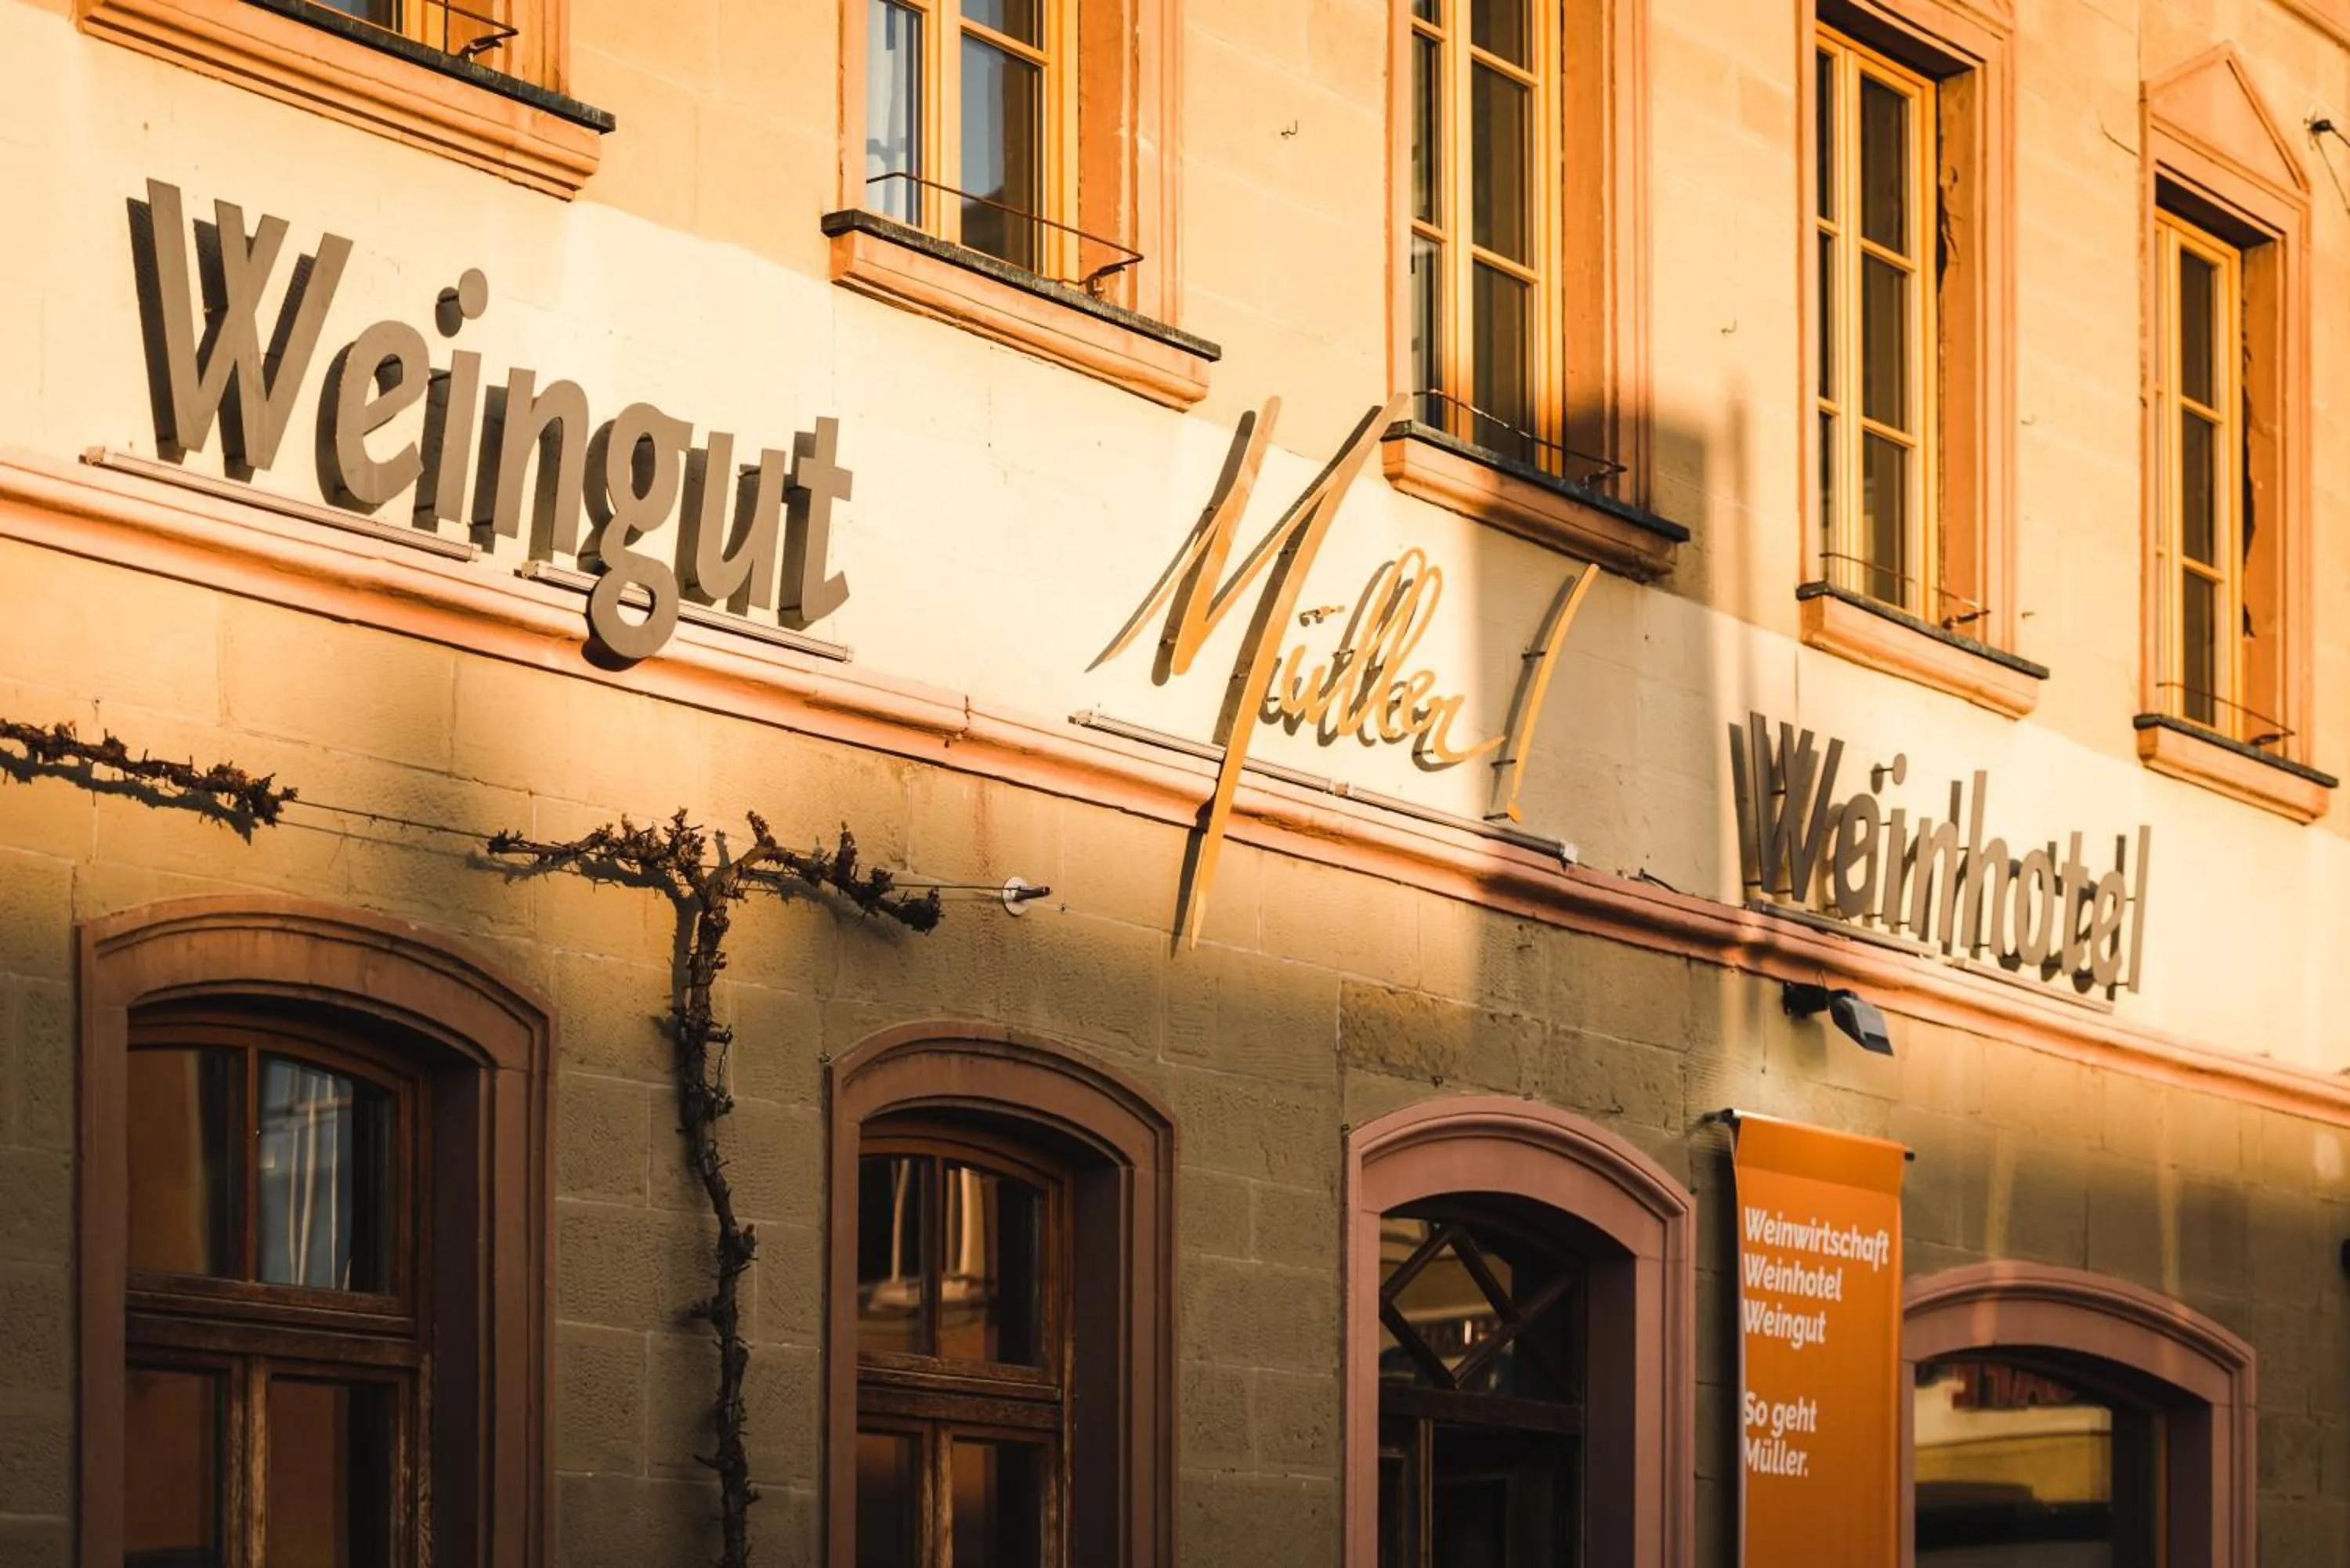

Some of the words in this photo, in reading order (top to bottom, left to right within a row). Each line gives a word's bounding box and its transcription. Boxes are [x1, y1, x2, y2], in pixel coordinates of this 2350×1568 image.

[146, 177, 852, 659] Weingut
[1749, 710, 2151, 993] Weinhotel
[1744, 1206, 1889, 1271] Weinwirtschaft
[1744, 1253, 1842, 1302] Weinhotel
[1744, 1299, 1826, 1350] Weingut
[1744, 1390, 1767, 1427] So
[1771, 1396, 1817, 1438] geht
[1744, 1436, 1809, 1478] Müller.
